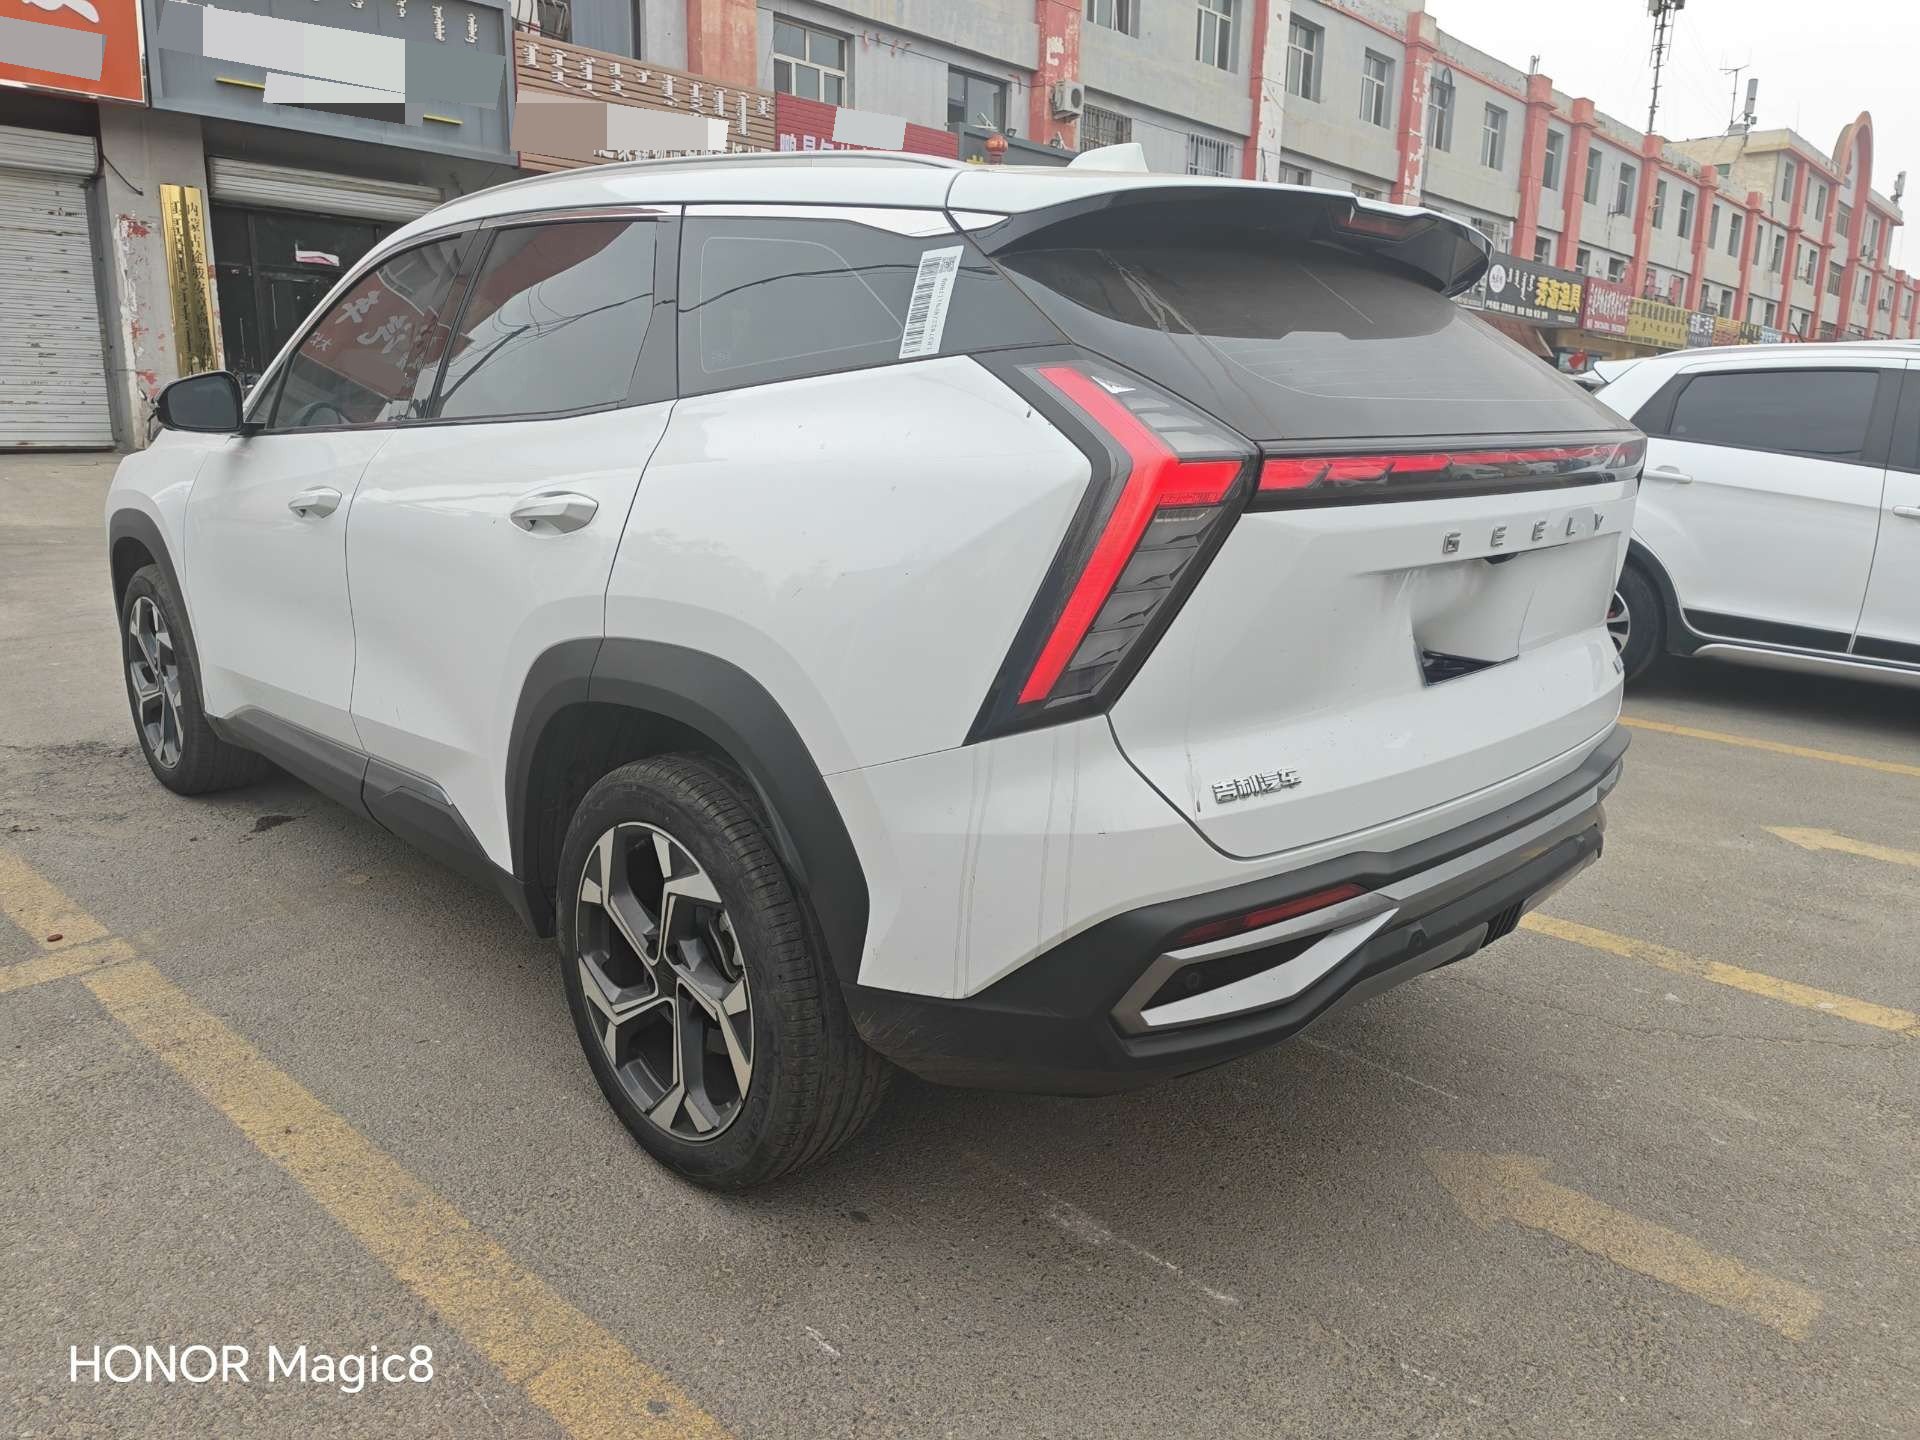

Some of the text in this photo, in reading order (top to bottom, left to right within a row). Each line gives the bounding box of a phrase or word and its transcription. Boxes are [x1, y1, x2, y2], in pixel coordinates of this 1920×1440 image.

[1443, 513, 1604, 553] GEELY
[1211, 769, 1302, 804] 吉利汽车
